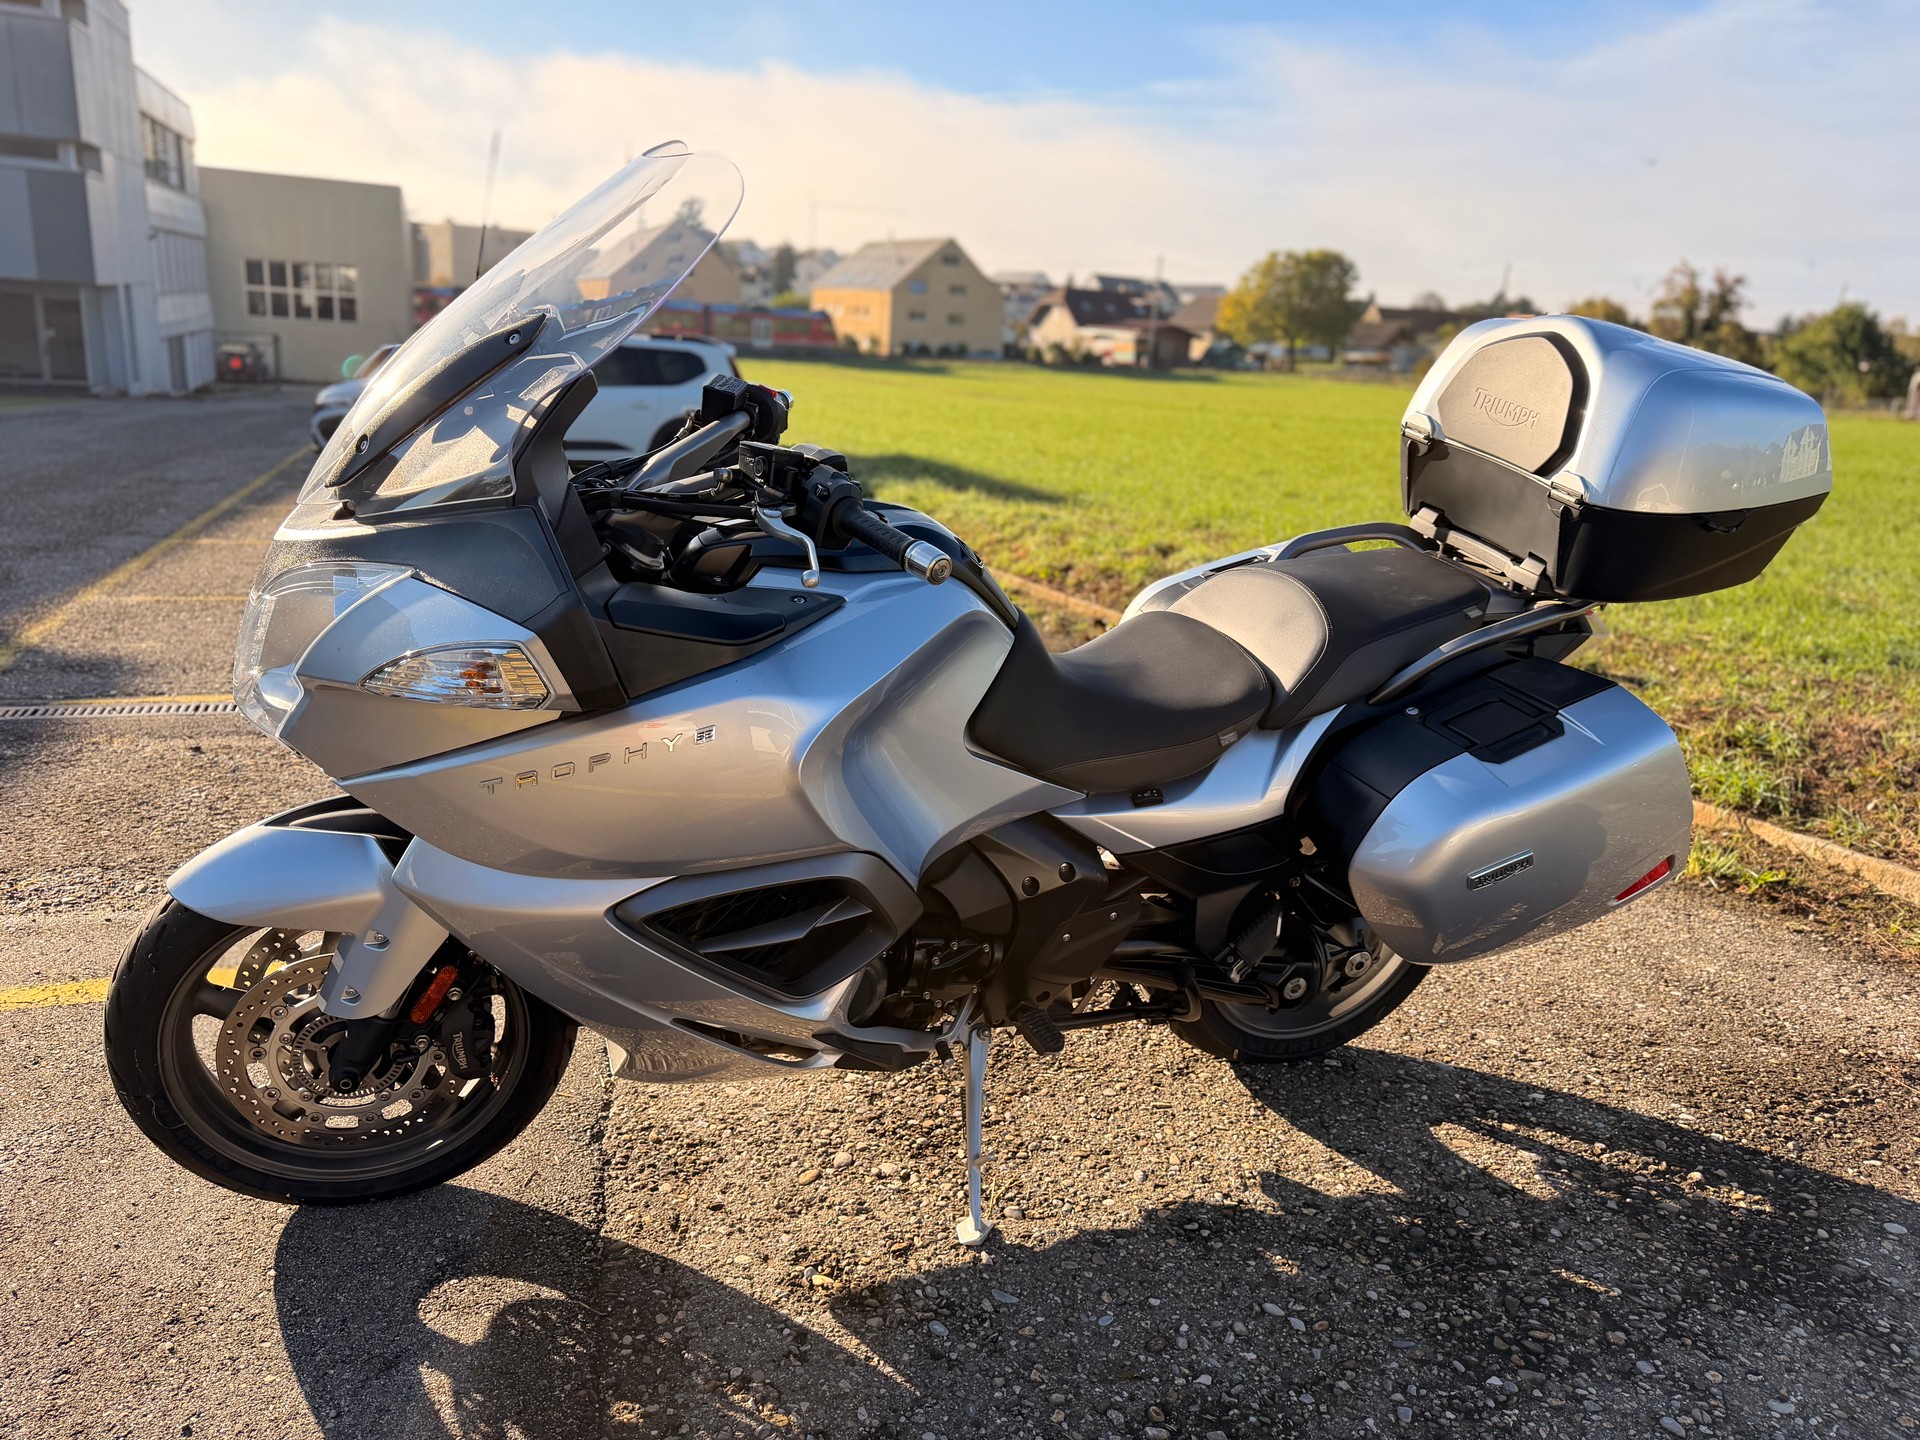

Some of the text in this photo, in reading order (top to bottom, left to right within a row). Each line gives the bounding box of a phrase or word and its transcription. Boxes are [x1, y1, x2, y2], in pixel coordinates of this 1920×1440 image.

[1473, 387, 1540, 428] TRIUMPH
[479, 732, 683, 795] TROPHY
[1474, 859, 1530, 887] TRIUMPH
[452, 1031, 468, 1070] TRIUMPH
